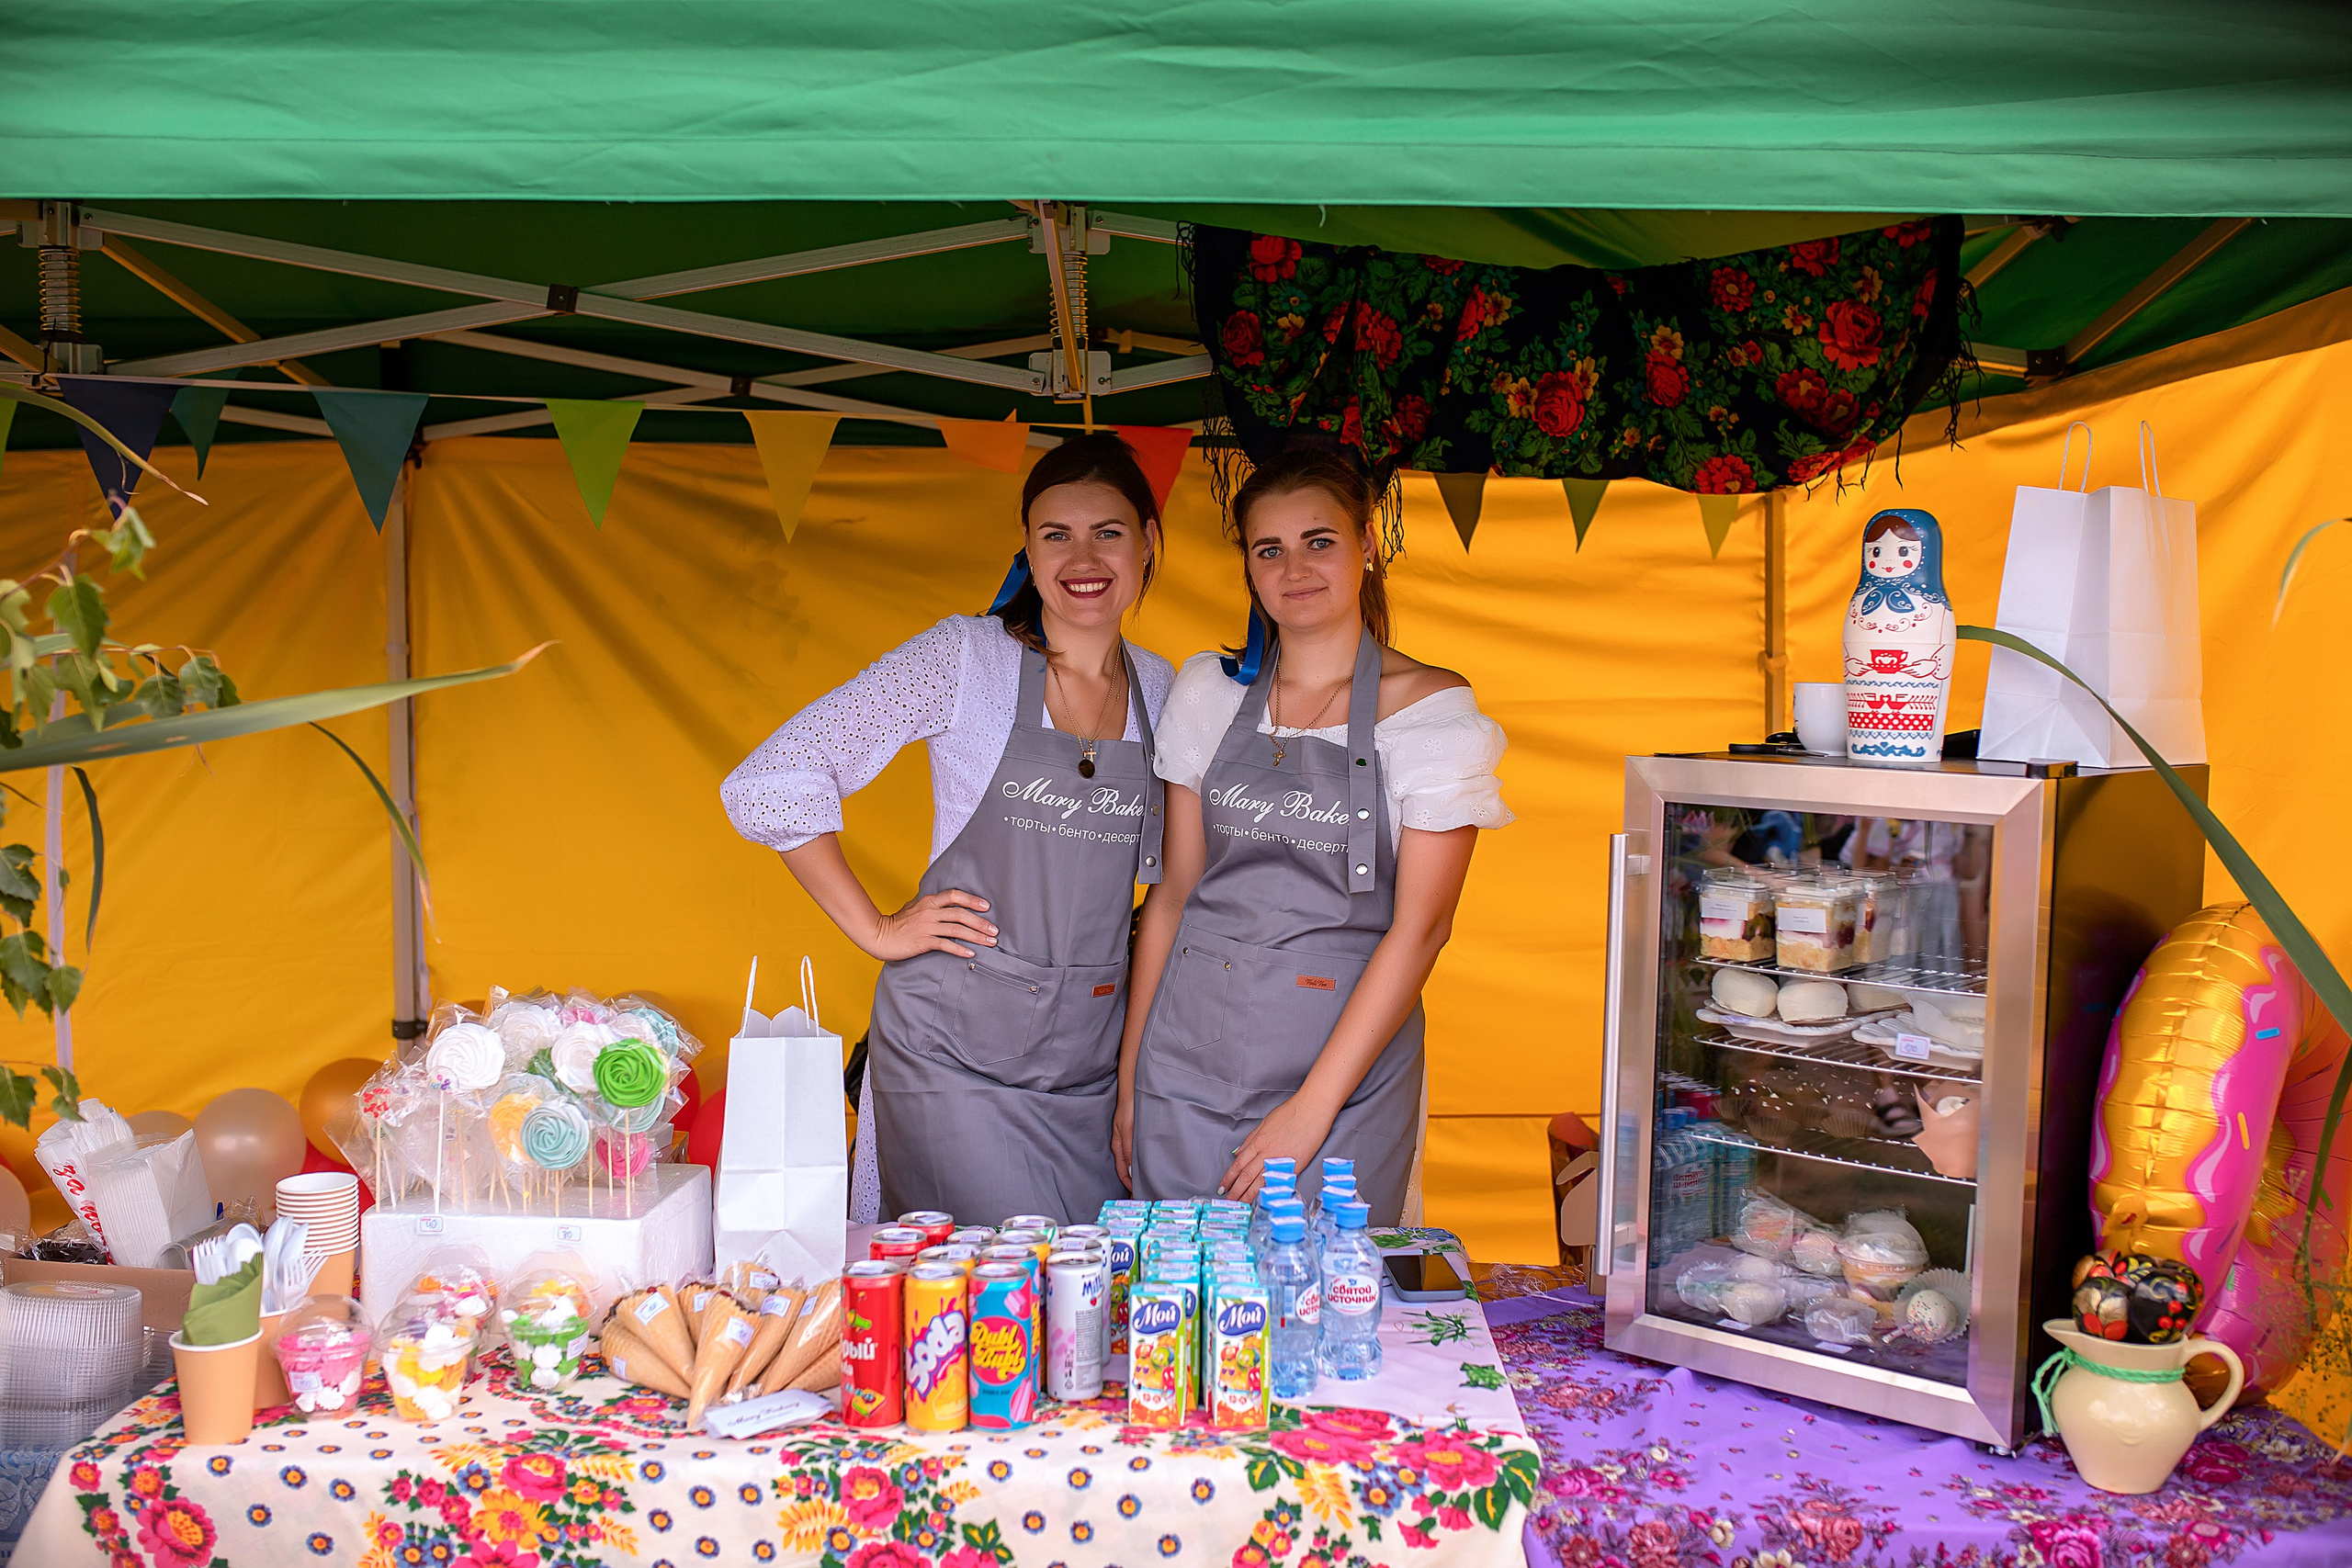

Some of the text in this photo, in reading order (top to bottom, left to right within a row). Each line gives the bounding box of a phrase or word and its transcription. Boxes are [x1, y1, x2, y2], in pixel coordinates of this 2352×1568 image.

[1002, 777, 1145, 819] Mary Bake
[1209, 783, 1350, 826] Mary Bake
[1296, 839, 1349, 855] десерт
[1111, 1244, 1129, 1264] ой
[1133, 1302, 1176, 1328] Мой
[1218, 1303, 1261, 1329] Мой
[969, 1321, 1019, 1346] Dubl
[842, 1337, 876, 1360] рый
